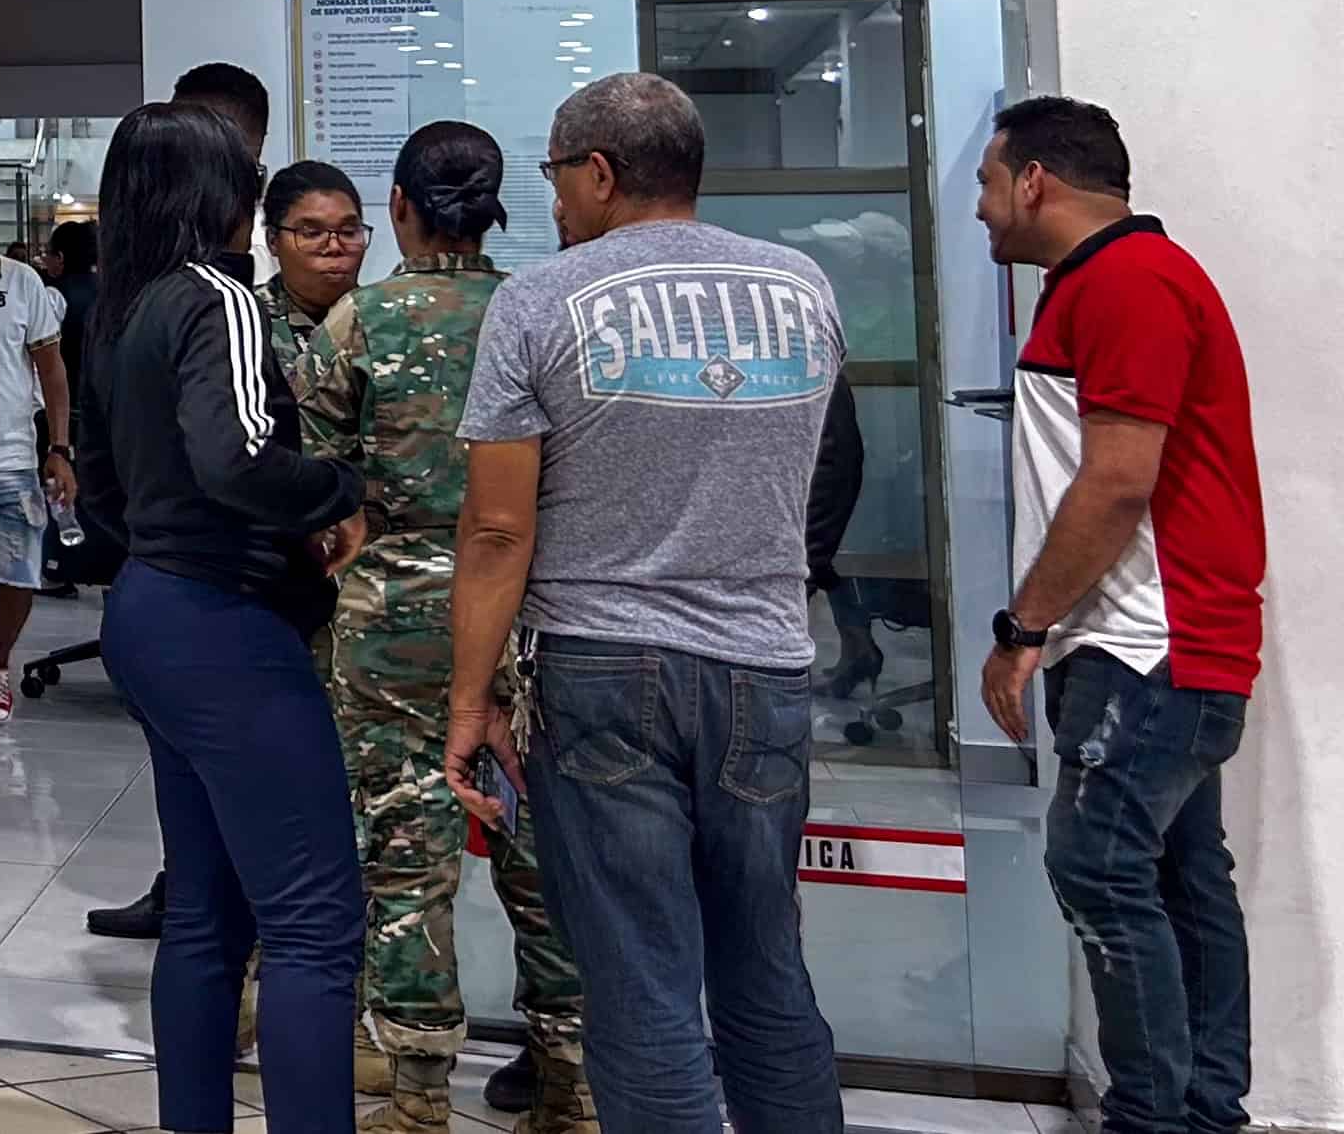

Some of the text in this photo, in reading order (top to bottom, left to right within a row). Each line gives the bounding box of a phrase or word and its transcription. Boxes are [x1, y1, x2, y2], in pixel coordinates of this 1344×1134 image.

[311, 8, 322, 16] DE
[324, 7, 369, 15] SERVICIOS
[346, 16, 380, 24] PUNTOS
[592, 281, 824, 380] SALT LIFE
[804, 838, 856, 871] ICA
